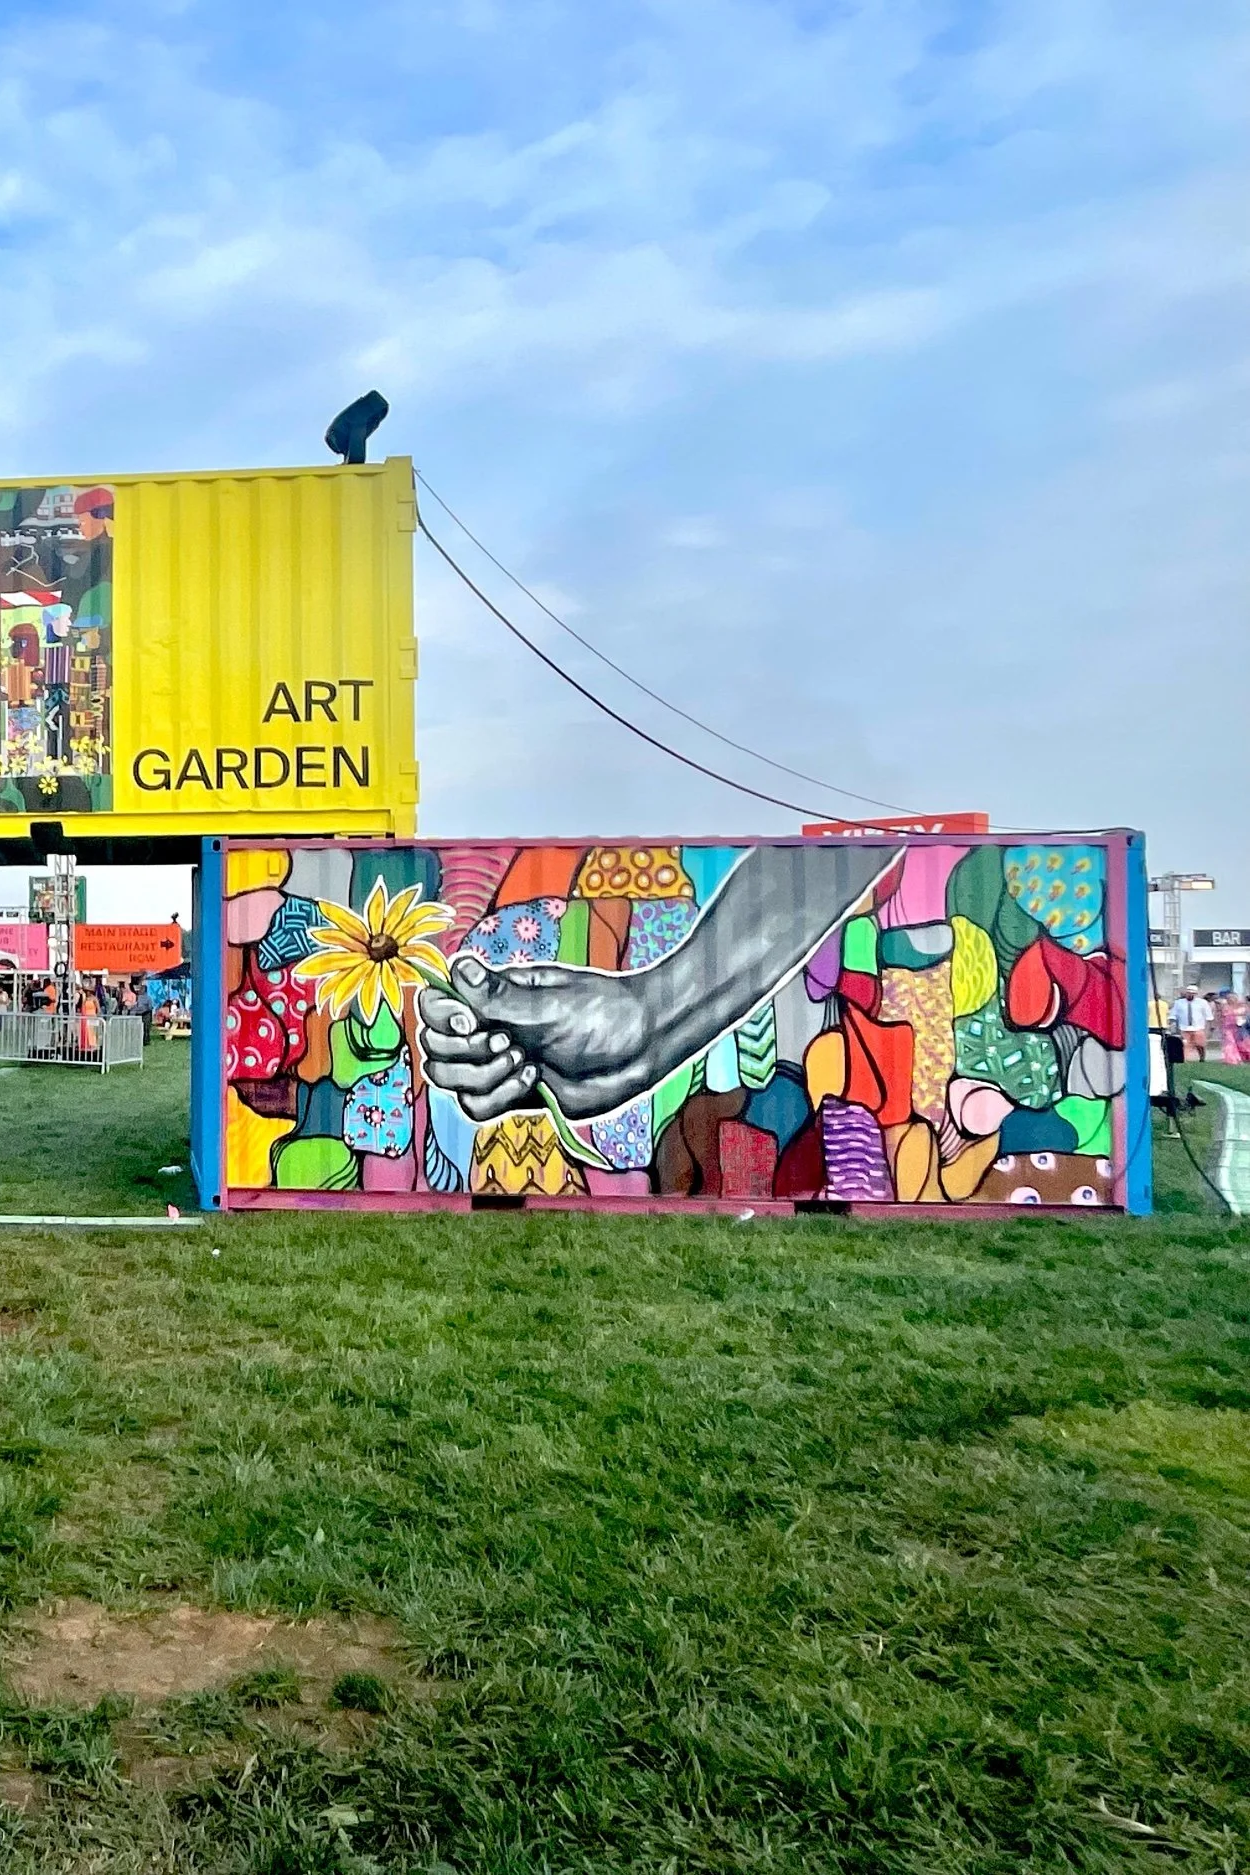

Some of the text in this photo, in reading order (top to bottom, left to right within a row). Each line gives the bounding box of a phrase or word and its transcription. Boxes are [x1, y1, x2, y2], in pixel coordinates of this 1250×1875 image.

[262, 680, 374, 723] ART
[133, 746, 369, 791] GARDEN
[85, 928, 158, 937] MAIN STAGE
[1212, 931, 1241, 946] BAR
[80, 942, 157, 951] RESTAURANT
[129, 954, 156, 963] ROW
